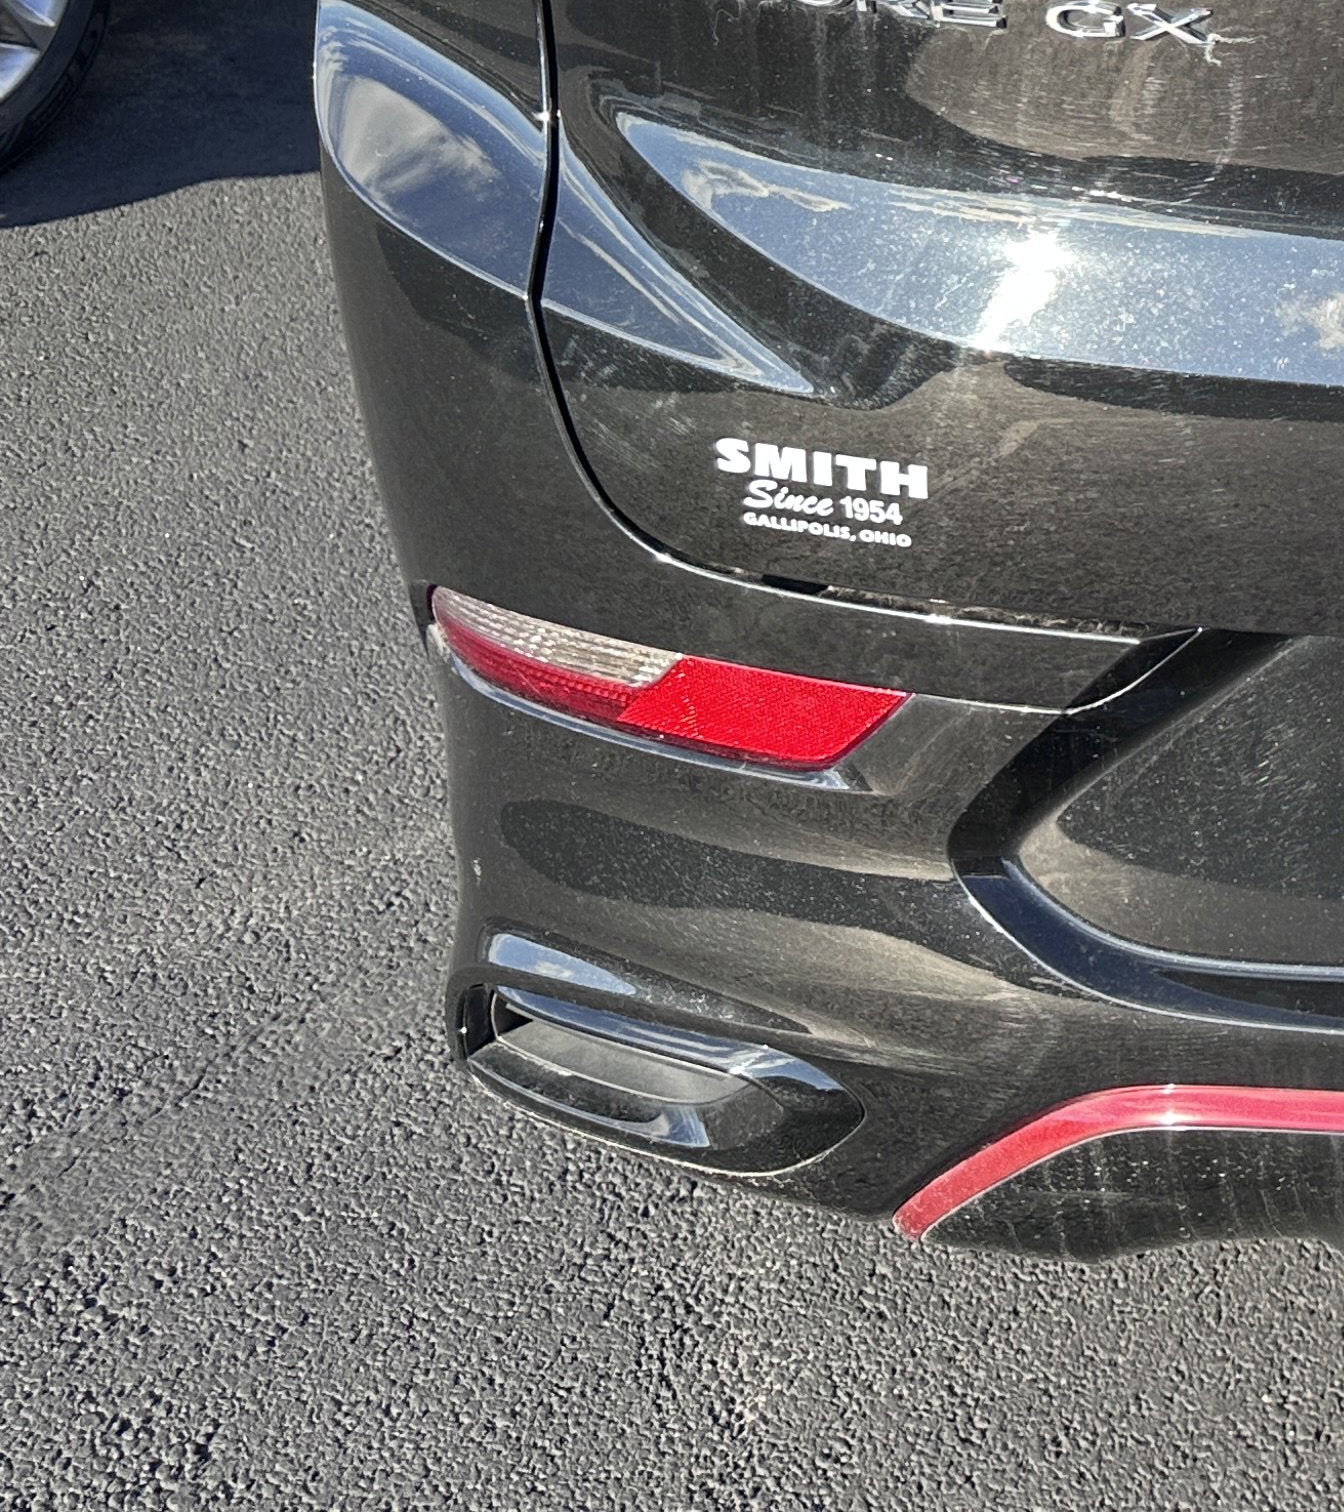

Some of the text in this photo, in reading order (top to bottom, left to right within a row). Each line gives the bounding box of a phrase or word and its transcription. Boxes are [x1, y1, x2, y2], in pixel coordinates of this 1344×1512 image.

[1045, 0, 1217, 45] GX
[715, 437, 929, 499] SMITH
[743, 479, 903, 526] Since 1954
[743, 511, 912, 548] GALLIPOLIS, OHIO
